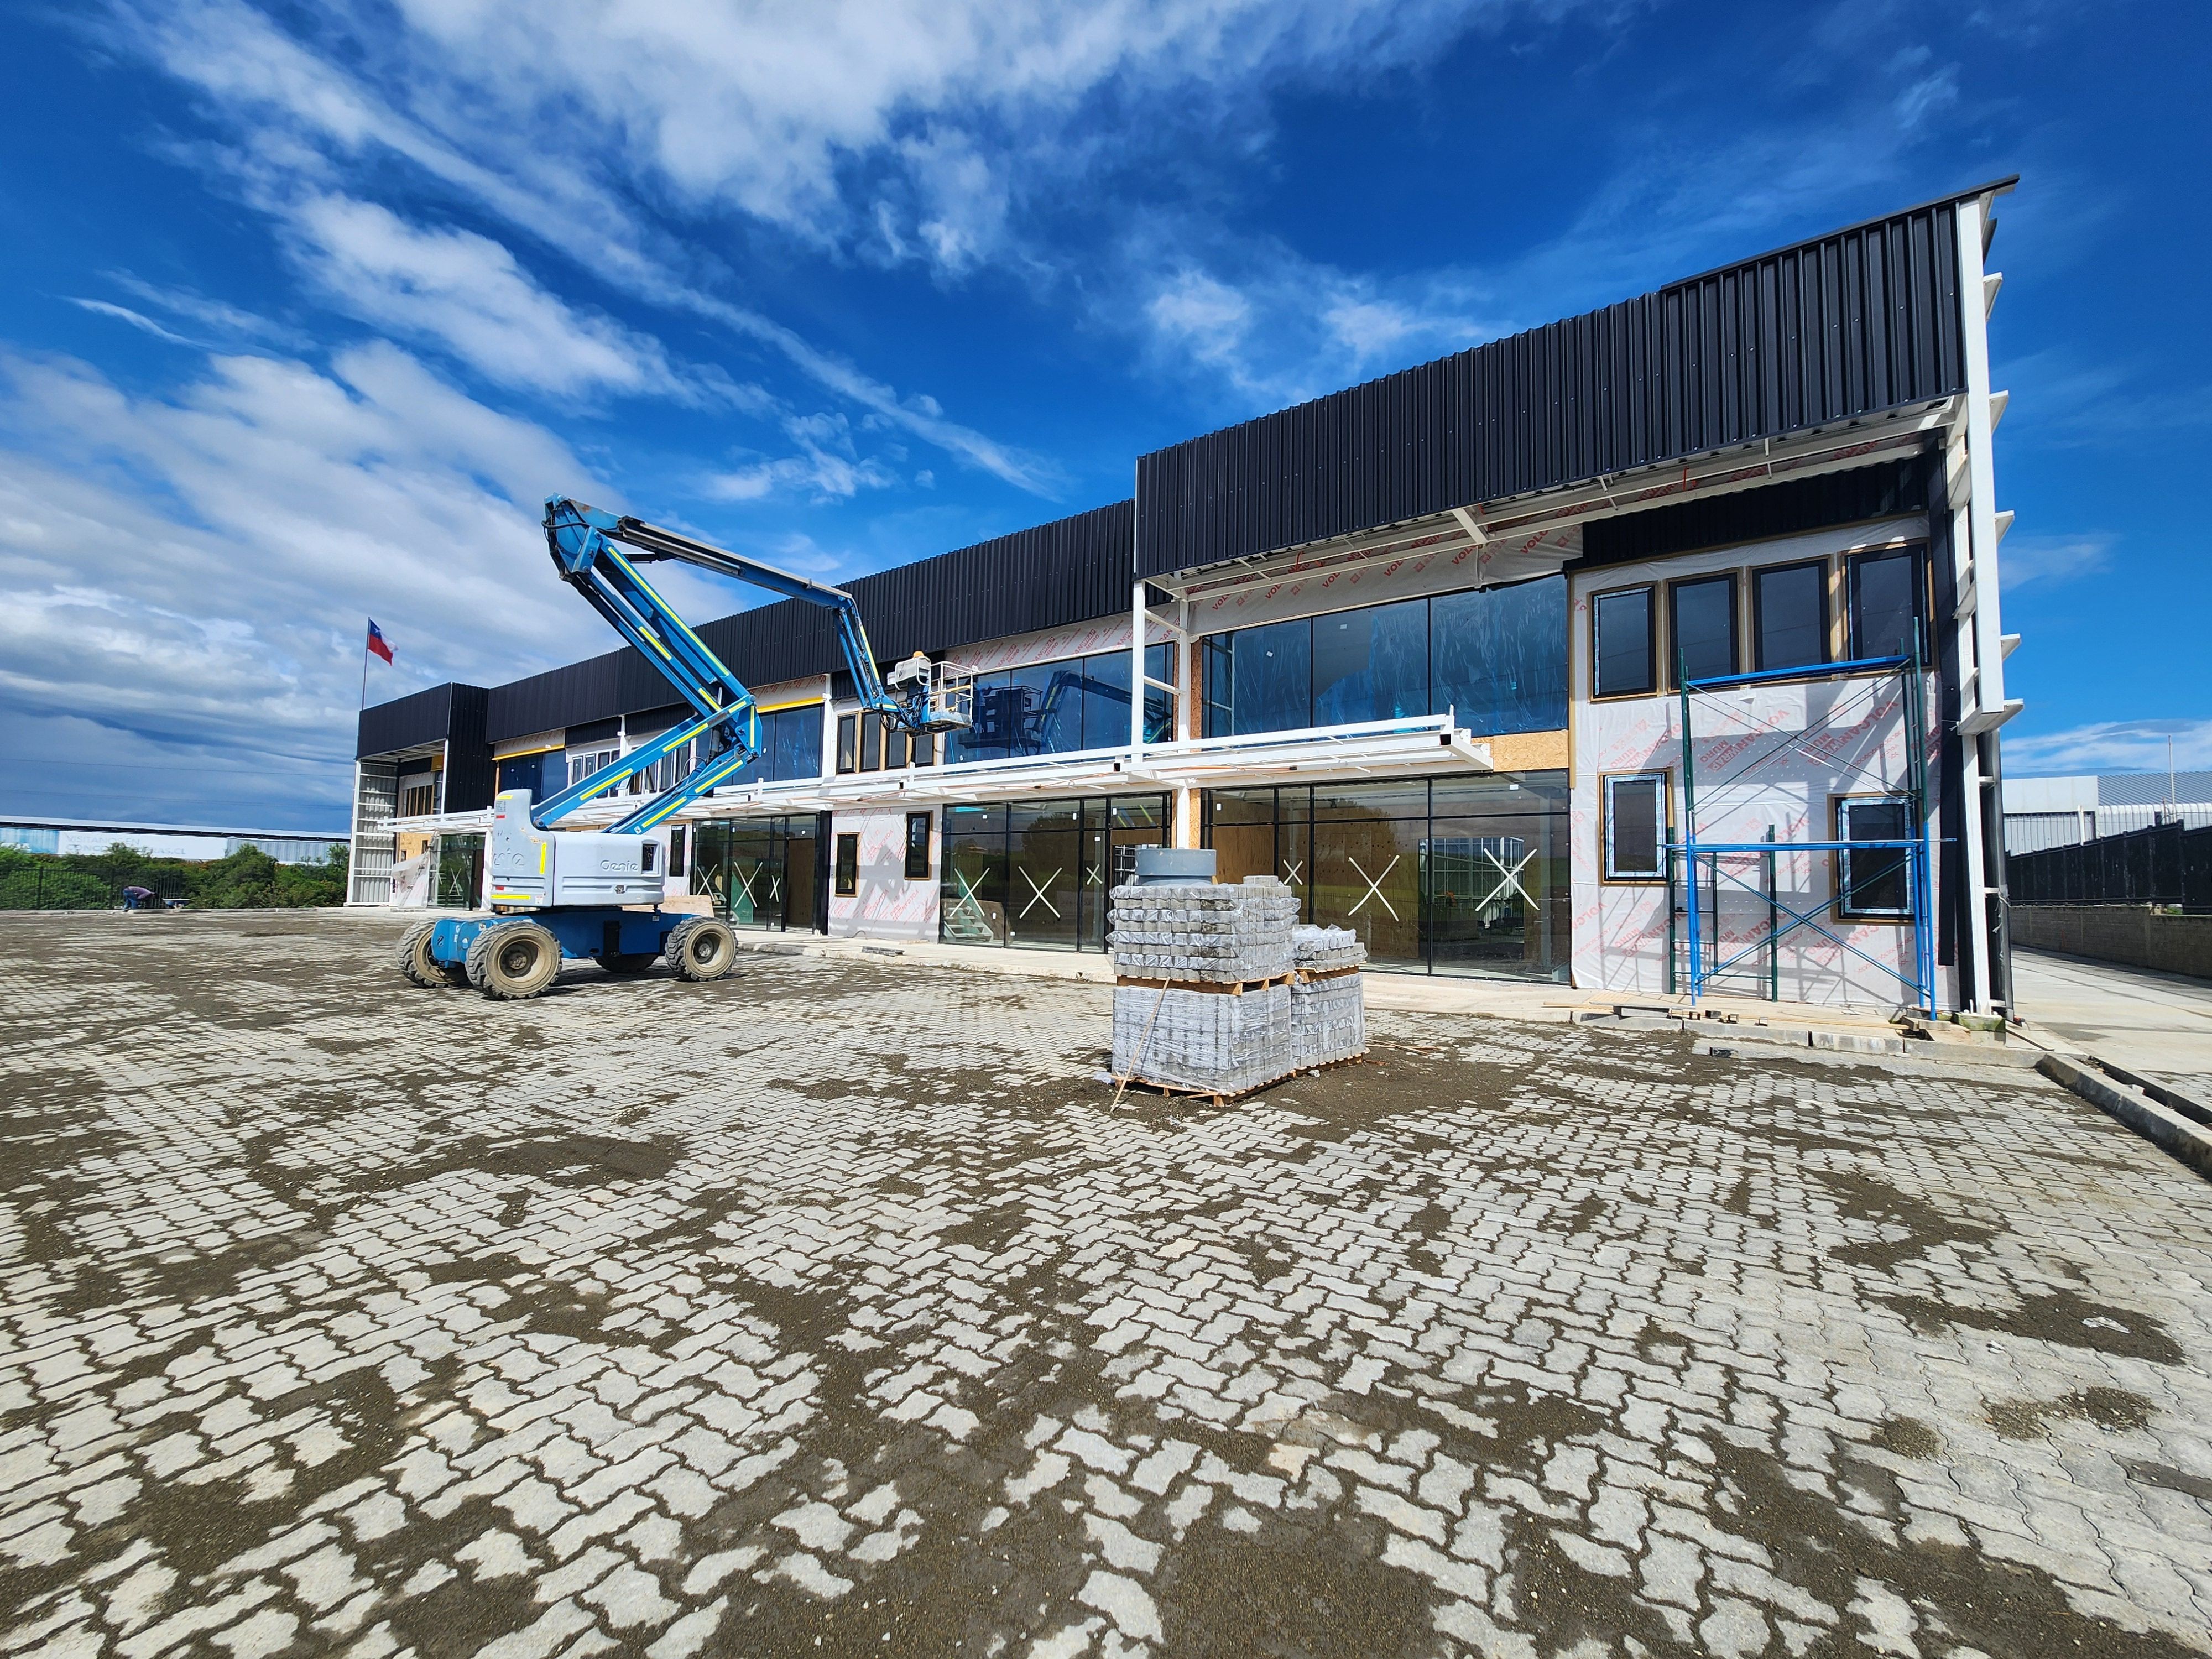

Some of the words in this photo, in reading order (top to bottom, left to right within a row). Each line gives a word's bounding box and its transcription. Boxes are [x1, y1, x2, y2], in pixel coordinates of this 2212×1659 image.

[1046, 642, 1058, 658] MURO
[1086, 634, 1099, 650] MURO
[1610, 747, 1636, 768] MURO
[1700, 740, 1728, 763] MURO
[600, 859, 638, 872] Genie
